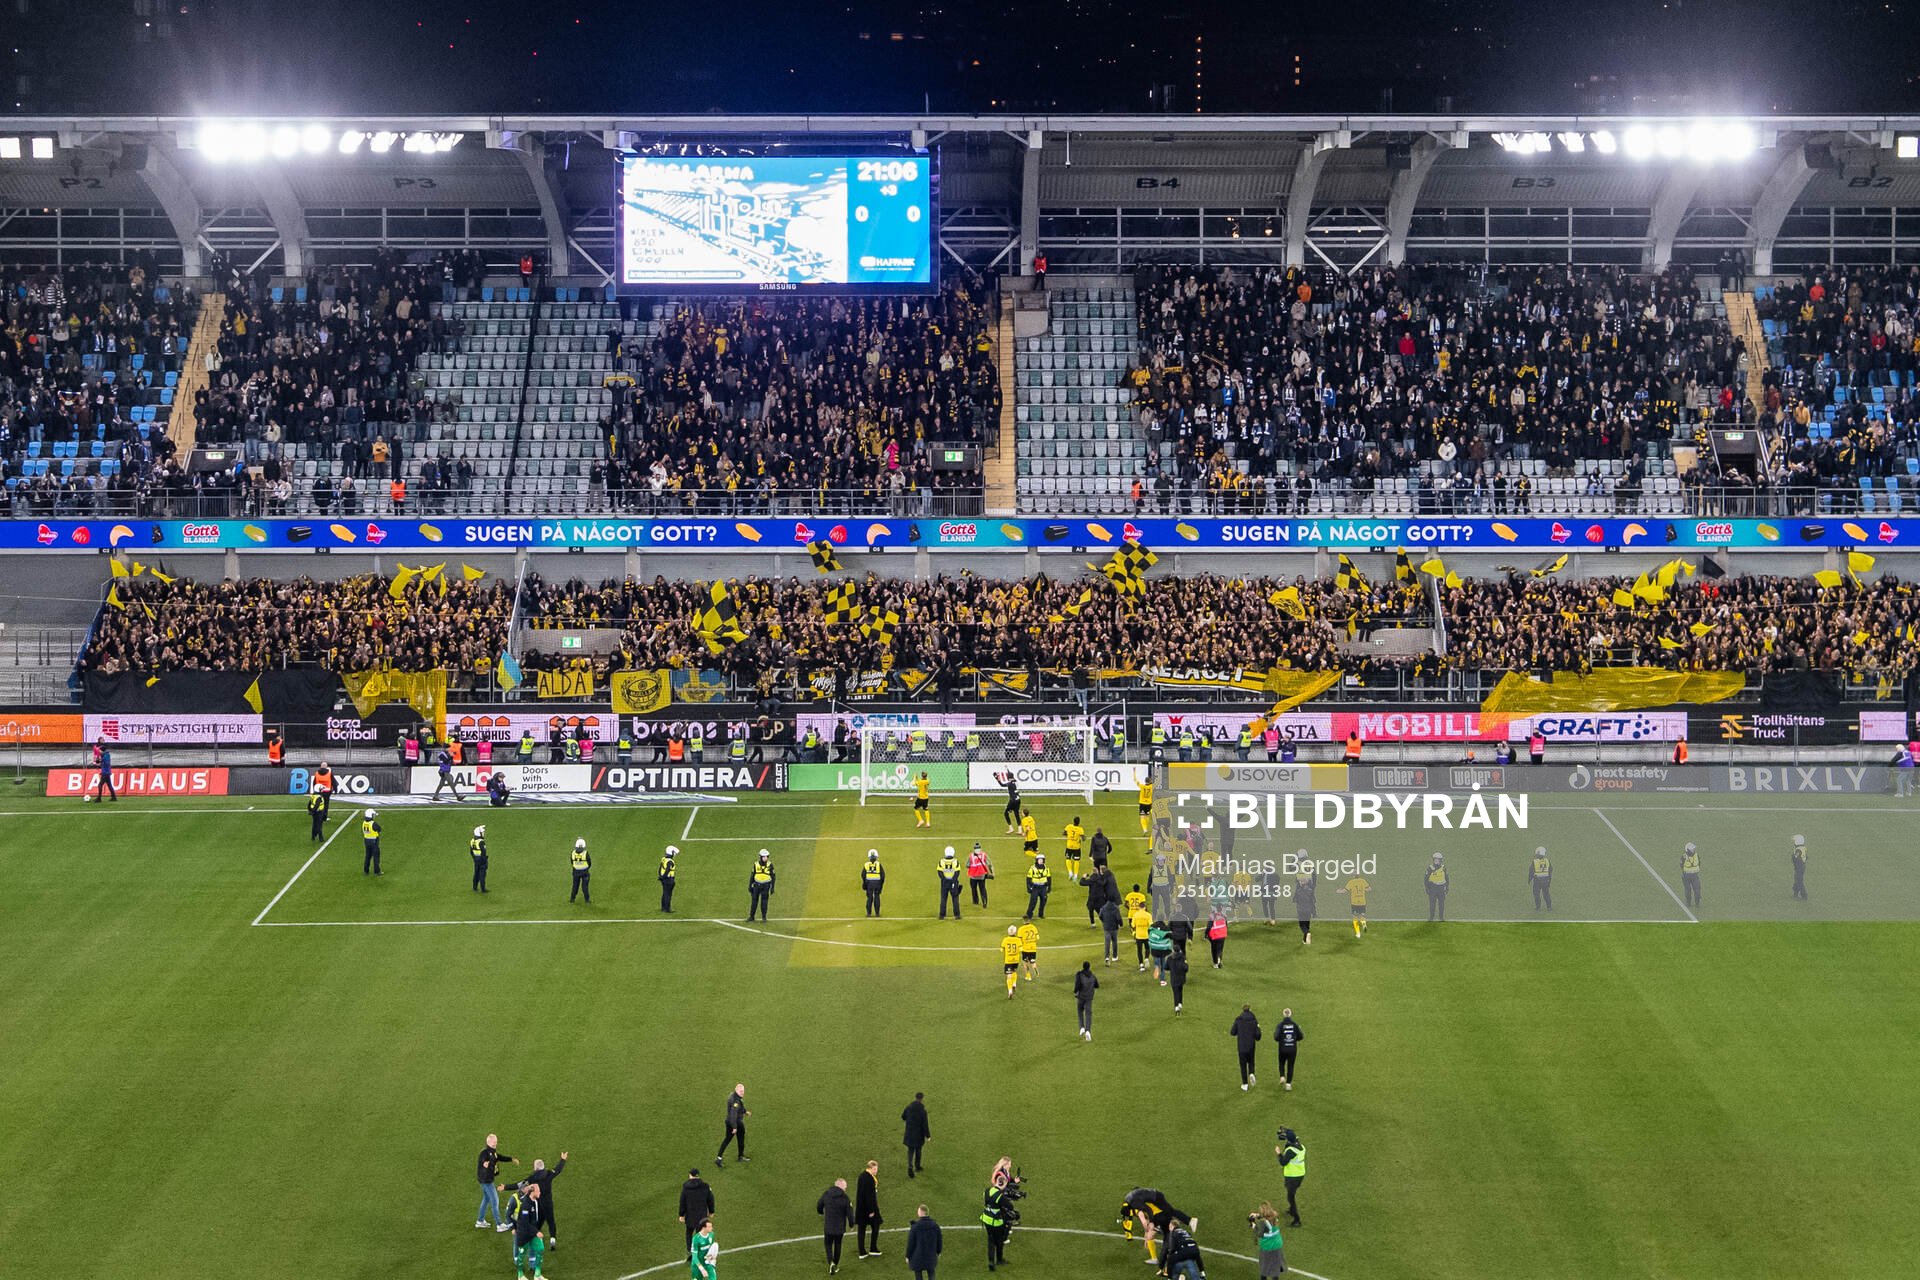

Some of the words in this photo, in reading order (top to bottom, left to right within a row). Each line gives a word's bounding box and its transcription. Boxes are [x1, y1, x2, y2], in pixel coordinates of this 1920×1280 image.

[857, 161, 918, 182] 21:06
[59, 178, 105, 189] P2
[393, 178, 436, 188] P3
[1136, 178, 1180, 188] B4
[1512, 178, 1556, 188] B3
[855, 205, 869, 222] 0
[906, 205, 921, 222] 0
[183, 523, 219, 537] Gott&
[465, 526, 533, 541] SUGEN
[541, 521, 566, 541] PÅ
[573, 521, 644, 541] NÅGOT
[650, 526, 717, 541] GOTT?
[940, 522, 976, 536] Gott&
[1222, 525, 1290, 541] SUGEN
[1297, 521, 1322, 541] PÅ
[1330, 521, 1400, 541] NÅGOT
[1407, 525, 1473, 541] GOTT?
[1696, 522, 1732, 536] Gott&
[539, 671, 587, 695] ALDA
[326, 717, 360, 728] forza
[1359, 713, 1481, 739] MOBILL
[1538, 718, 1631, 735] CRAFT
[1752, 714, 1825, 726] Trollhättans
[326, 728, 377, 740] football
[1276, 725, 1319, 740] ASTA
[1752, 727, 1785, 738] Truck
[522, 766, 548, 774] Doors
[1377, 767, 1415, 786] weber
[1453, 767, 1491, 786] weber
[1594, 766, 1624, 778] next
[1626, 765, 1668, 781] safety
[67, 773, 207, 790] BAUHAUS
[607, 767, 754, 789] OPTIMERA
[1594, 779, 1633, 791] group
[1728, 767, 1867, 791] BRIXLY
[522, 782, 561, 791] purpose.
[1130, 897, 1140, 907] 26
[1025, 930, 1034, 940] 22
[1007, 943, 1017, 953] 39
